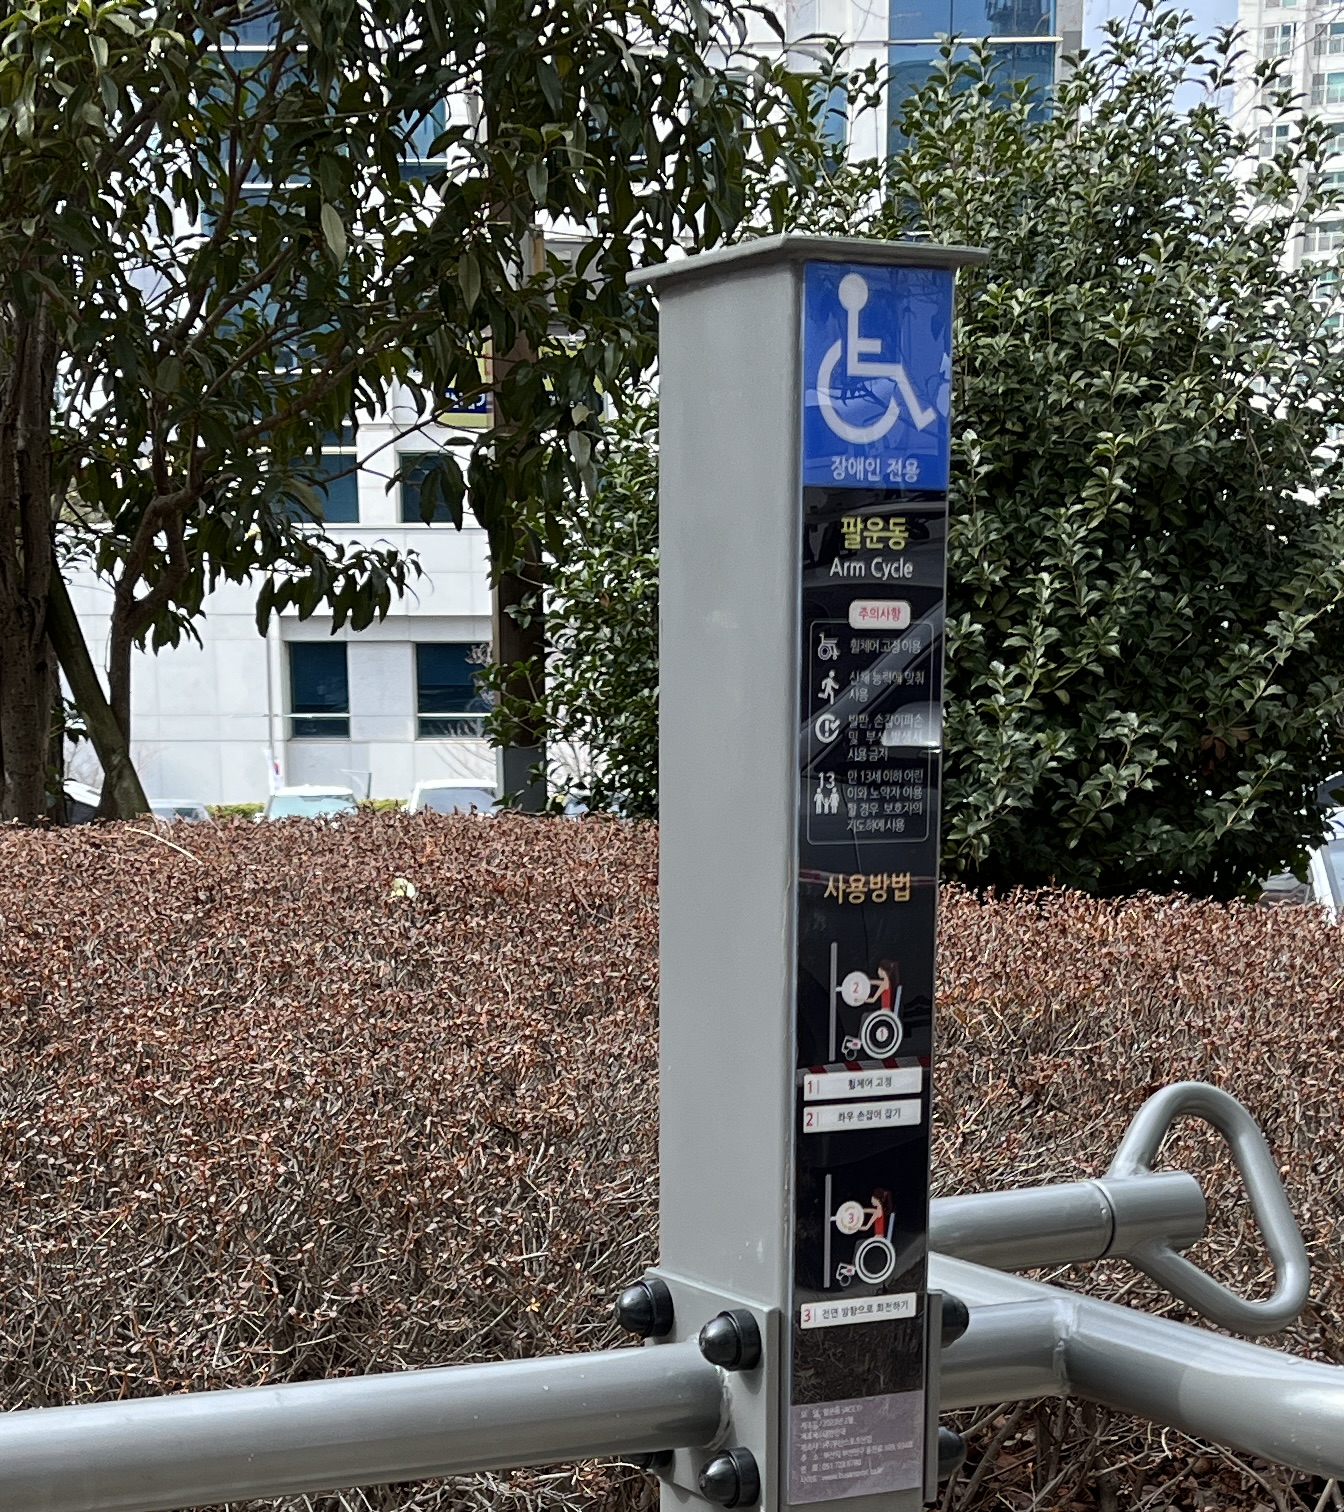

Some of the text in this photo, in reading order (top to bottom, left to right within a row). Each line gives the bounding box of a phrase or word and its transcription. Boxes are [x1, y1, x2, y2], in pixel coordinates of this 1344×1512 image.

[831, 455, 920, 483] 장애인 전용
[840, 516, 909, 550] 팔운동
[829, 557, 913, 581] Arm Cycle
[858, 606, 902, 622] 주의사항
[849, 687, 869, 703] 사용
[818, 771, 836, 789] 13
[904, 769, 924, 783] 어린
[870, 786, 900, 800] 노약자
[903, 786, 923, 799] 이용
[883, 802, 923, 815] 보호자의
[823, 872, 911, 905] 사용방법
[852, 982, 859, 994] 2
[807, 1080, 813, 1094] 1
[806, 1113, 813, 1127] 2
[848, 1213, 855, 1224] 3
[803, 1309, 811, 1323] 3
